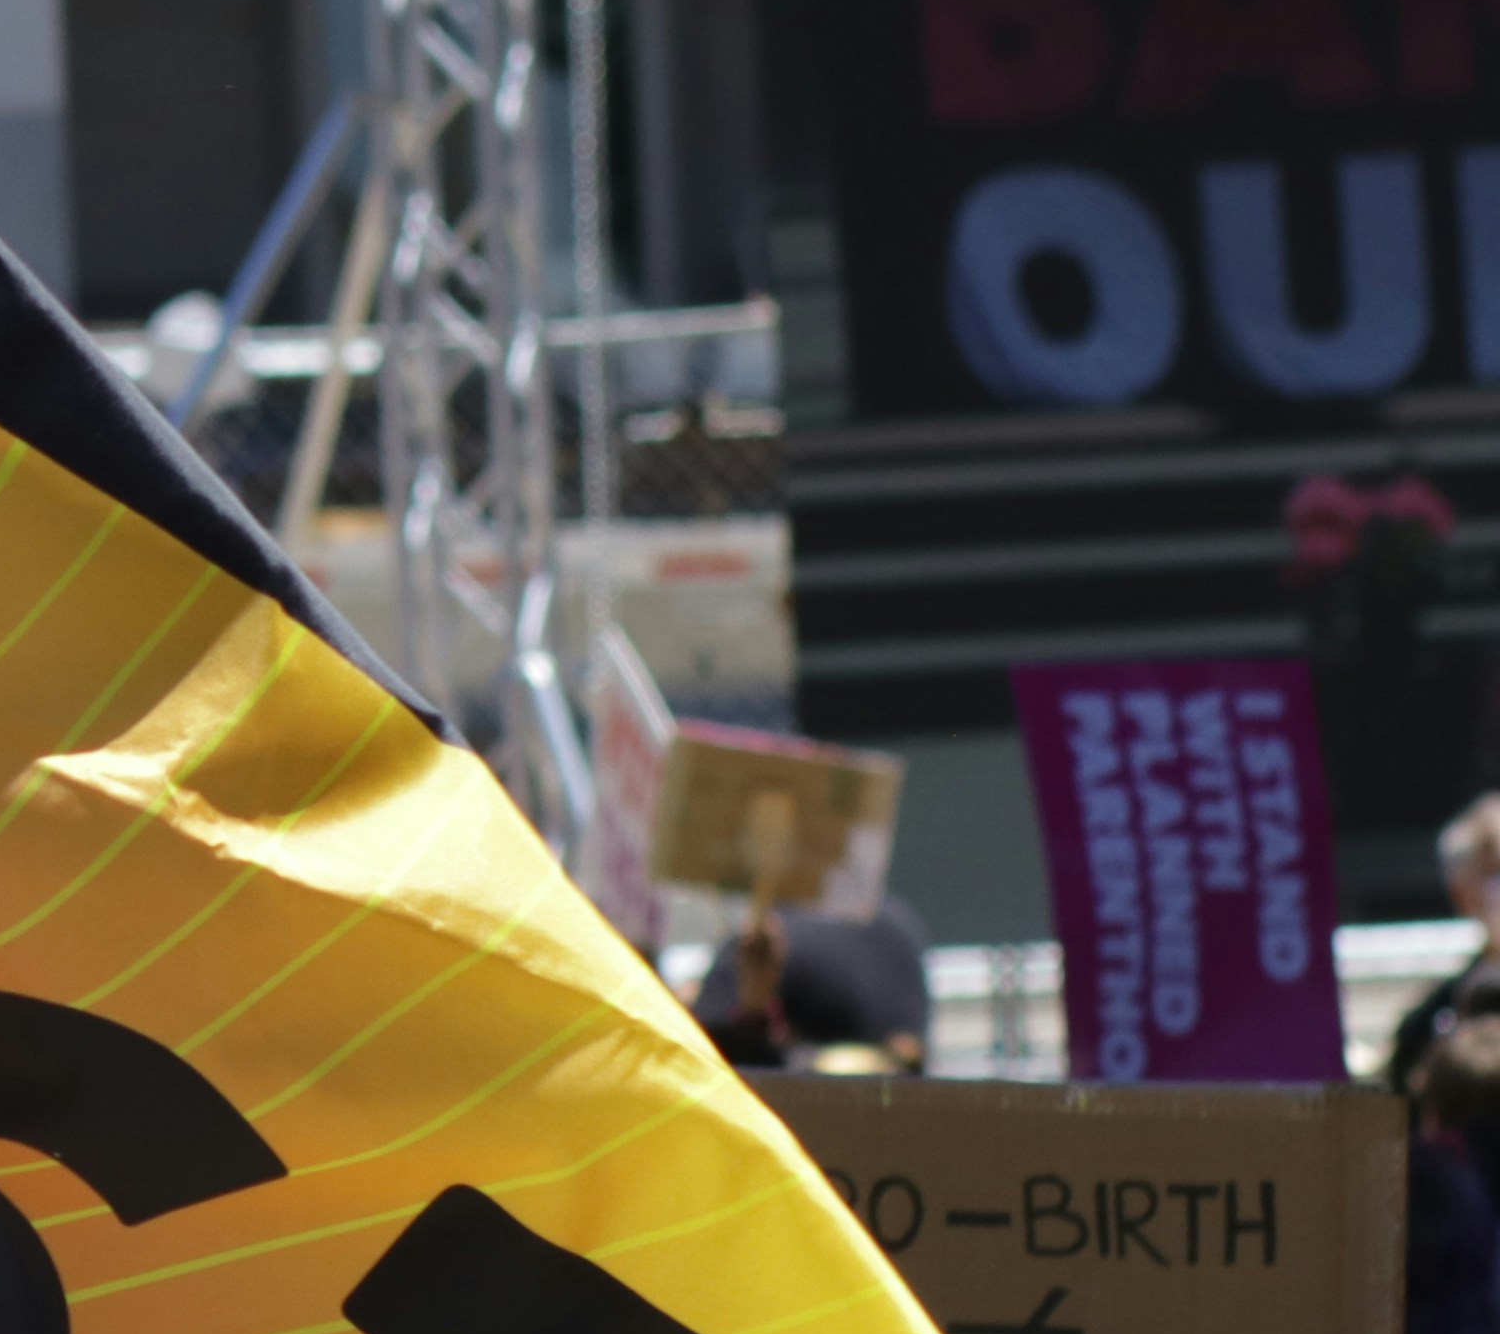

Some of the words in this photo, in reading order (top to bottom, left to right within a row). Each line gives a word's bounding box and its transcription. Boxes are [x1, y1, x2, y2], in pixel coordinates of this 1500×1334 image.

[949, 145, 1500, 409] OU
[1181, 689, 1248, 893] WITH
[1234, 691, 1285, 720] I
[1121, 689, 1201, 1039] PLANNED
[1238, 733, 1311, 983] STAND
